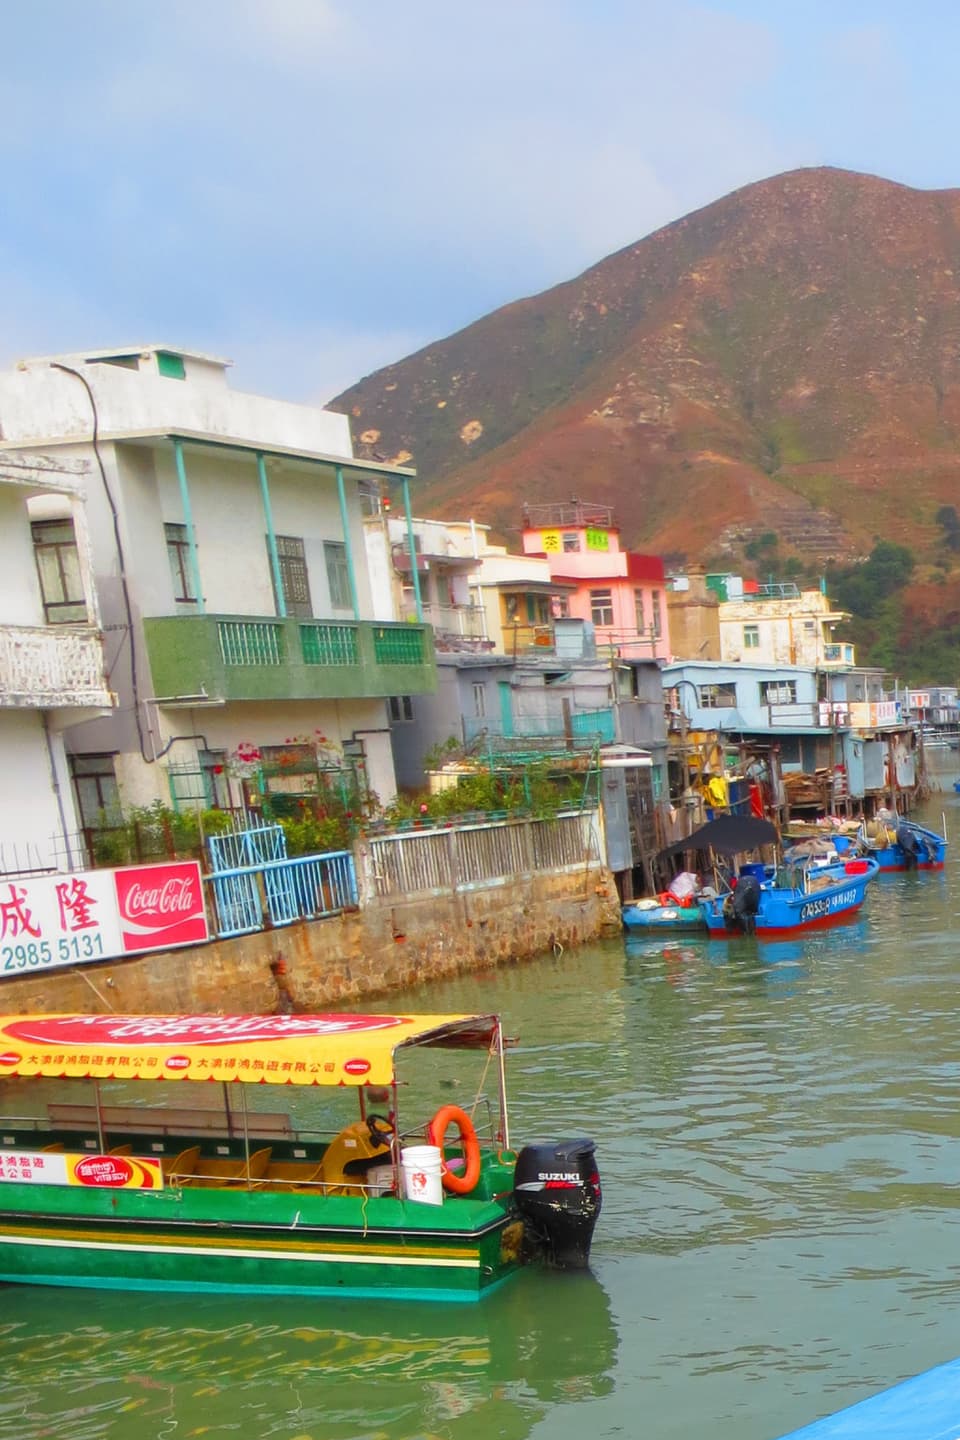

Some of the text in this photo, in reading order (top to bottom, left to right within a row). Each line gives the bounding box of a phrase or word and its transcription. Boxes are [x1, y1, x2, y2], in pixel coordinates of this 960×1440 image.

[125, 877, 194, 918] Coca-Cola
[3, 933, 103, 971] 2985 5131
[538, 1173, 580, 1181] SUZUKI
